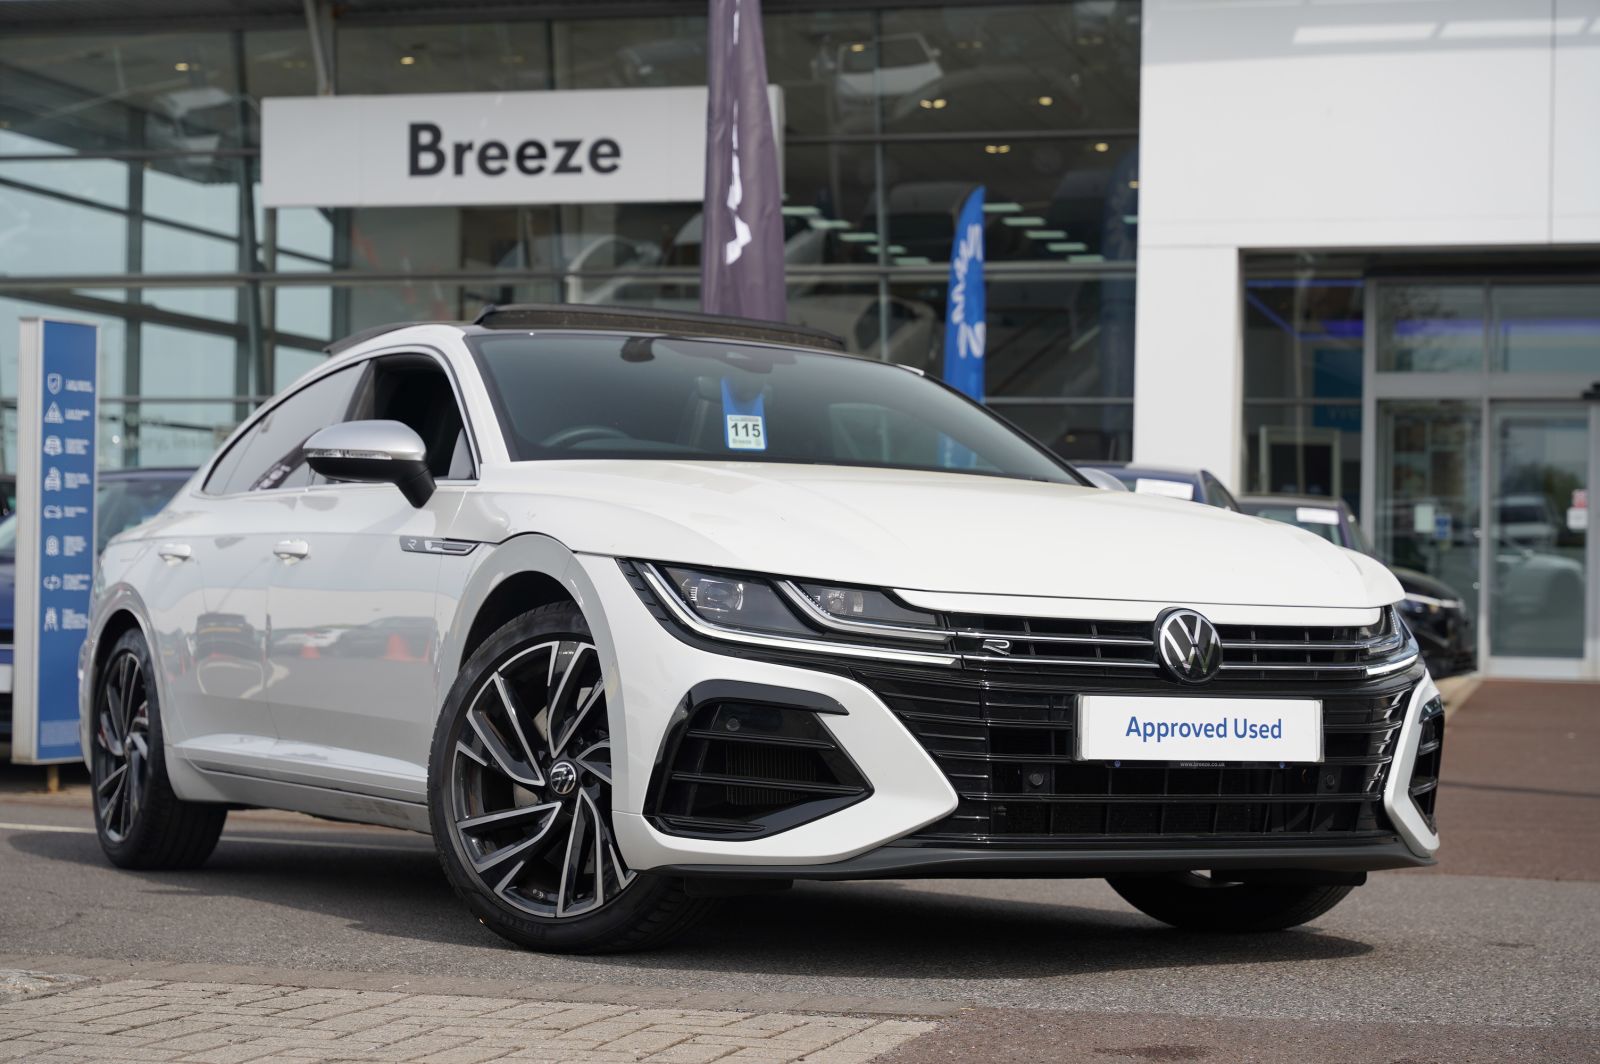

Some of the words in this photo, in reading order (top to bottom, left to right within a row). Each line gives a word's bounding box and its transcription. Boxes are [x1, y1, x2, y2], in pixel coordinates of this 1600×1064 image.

[408, 121, 622, 178] Breeze
[731, 422, 761, 438] 115
[1125, 715, 1228, 743] Approved
[1233, 718, 1283, 740] Used
